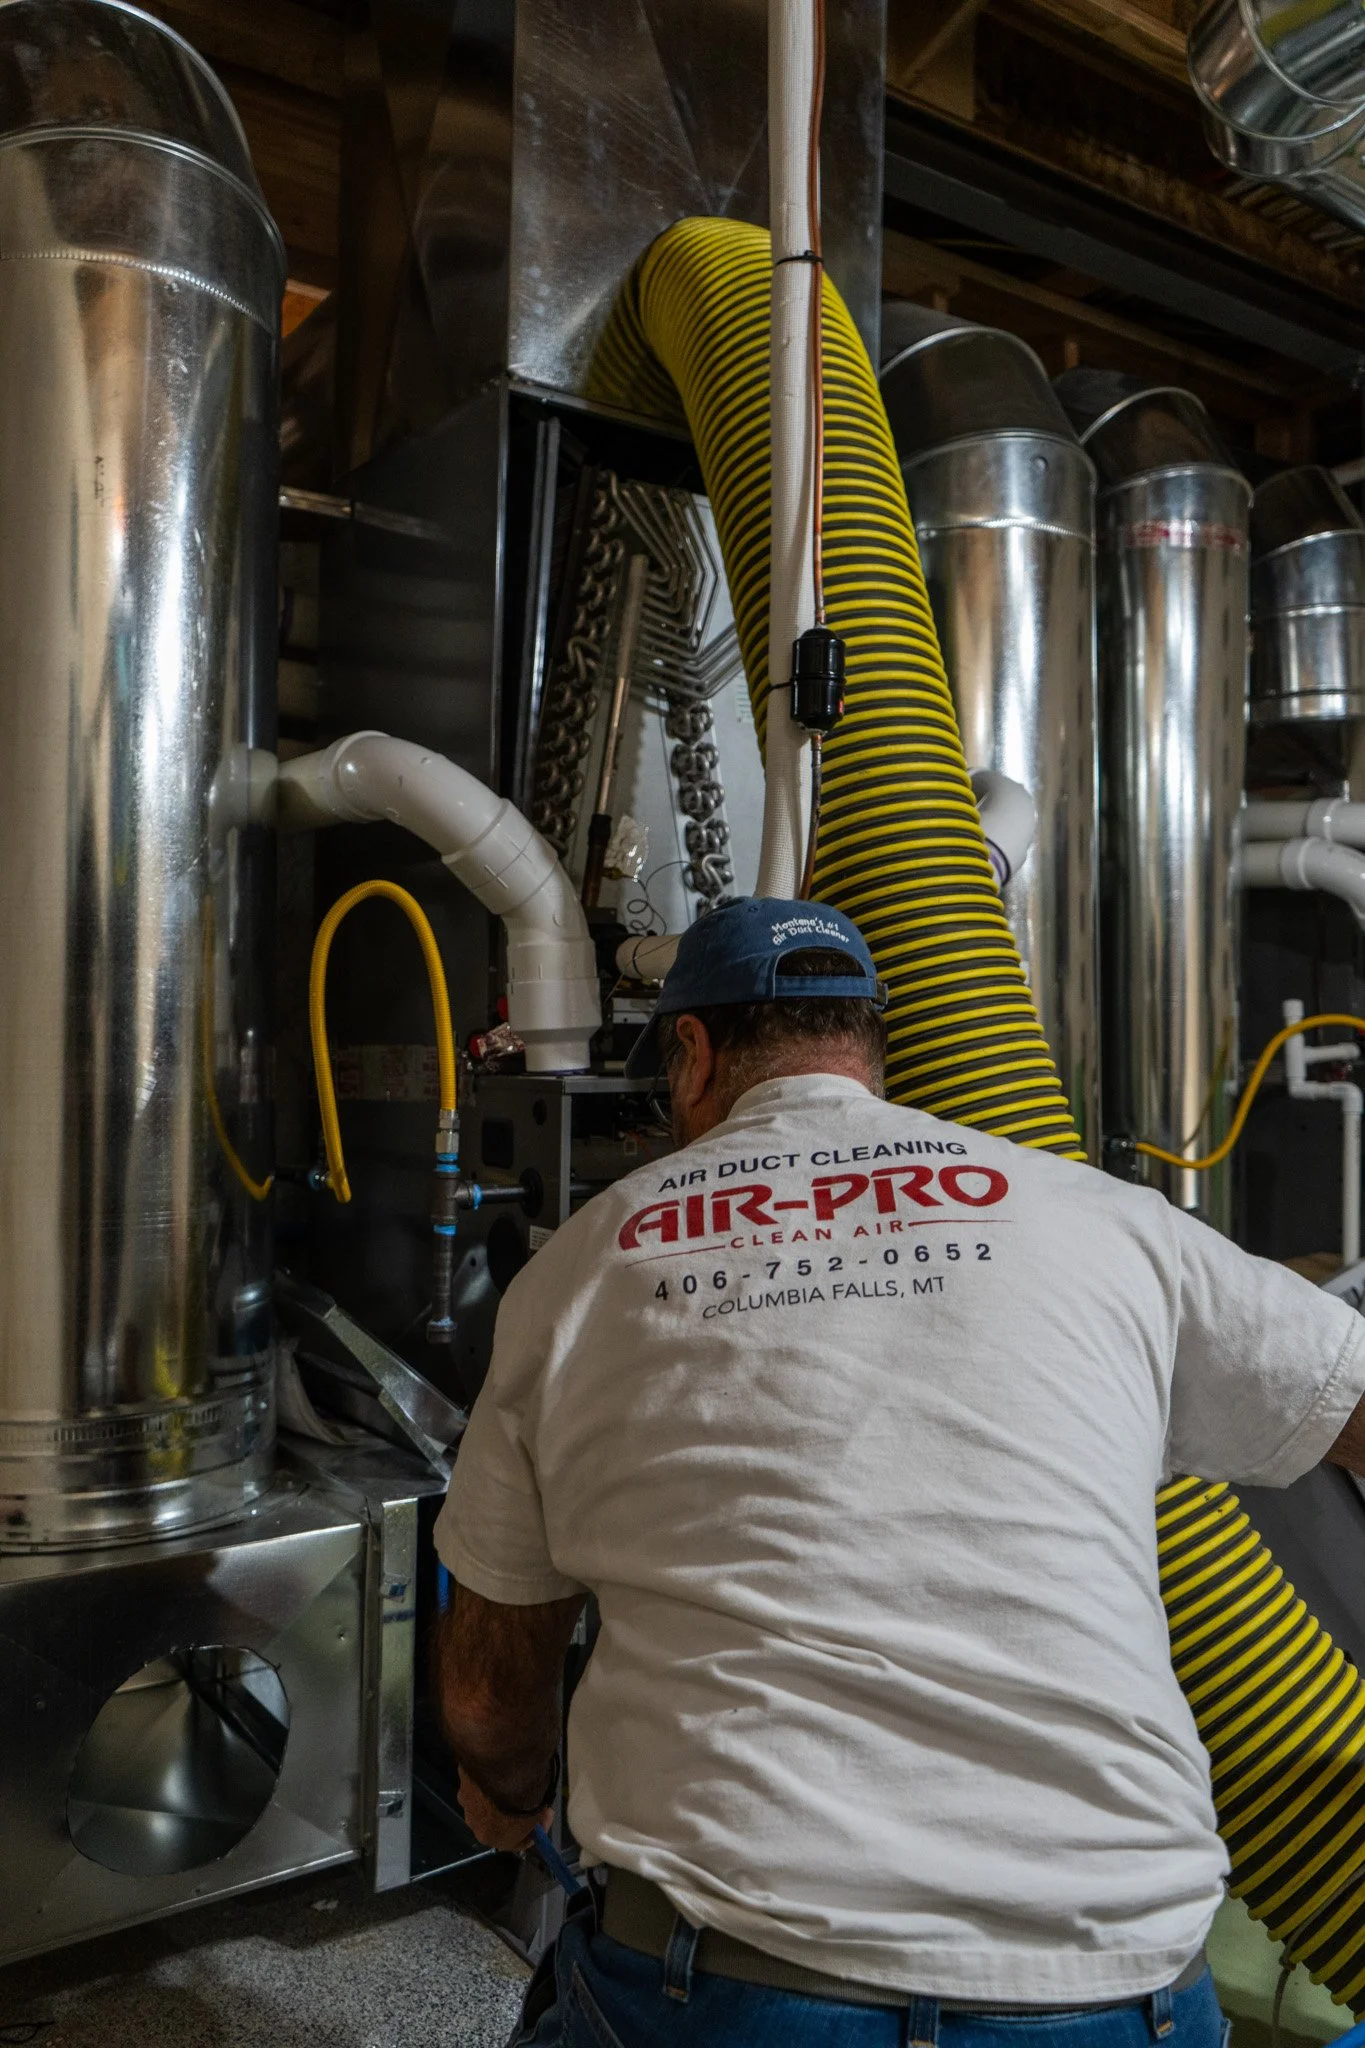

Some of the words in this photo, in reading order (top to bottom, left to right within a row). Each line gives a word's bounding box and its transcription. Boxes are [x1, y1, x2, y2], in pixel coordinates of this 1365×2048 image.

[788, 926, 813, 936] Duct
[815, 924, 850, 943] Cleaner
[658, 1169, 707, 1193] AIR
[718, 1154, 800, 1178] DUCT
[810, 1141, 968, 1166] CLEANING
[618, 1165, 1009, 1250] AIR-PRO
[730, 1228, 832, 1249] CLEAN
[853, 1220, 904, 1238] AIR
[655, 1243, 992, 1301] 406-752-0652
[702, 1286, 825, 1319] COLUMBIA
[832, 1280, 905, 1299] FALLS,
[912, 1276, 945, 1295] MT
